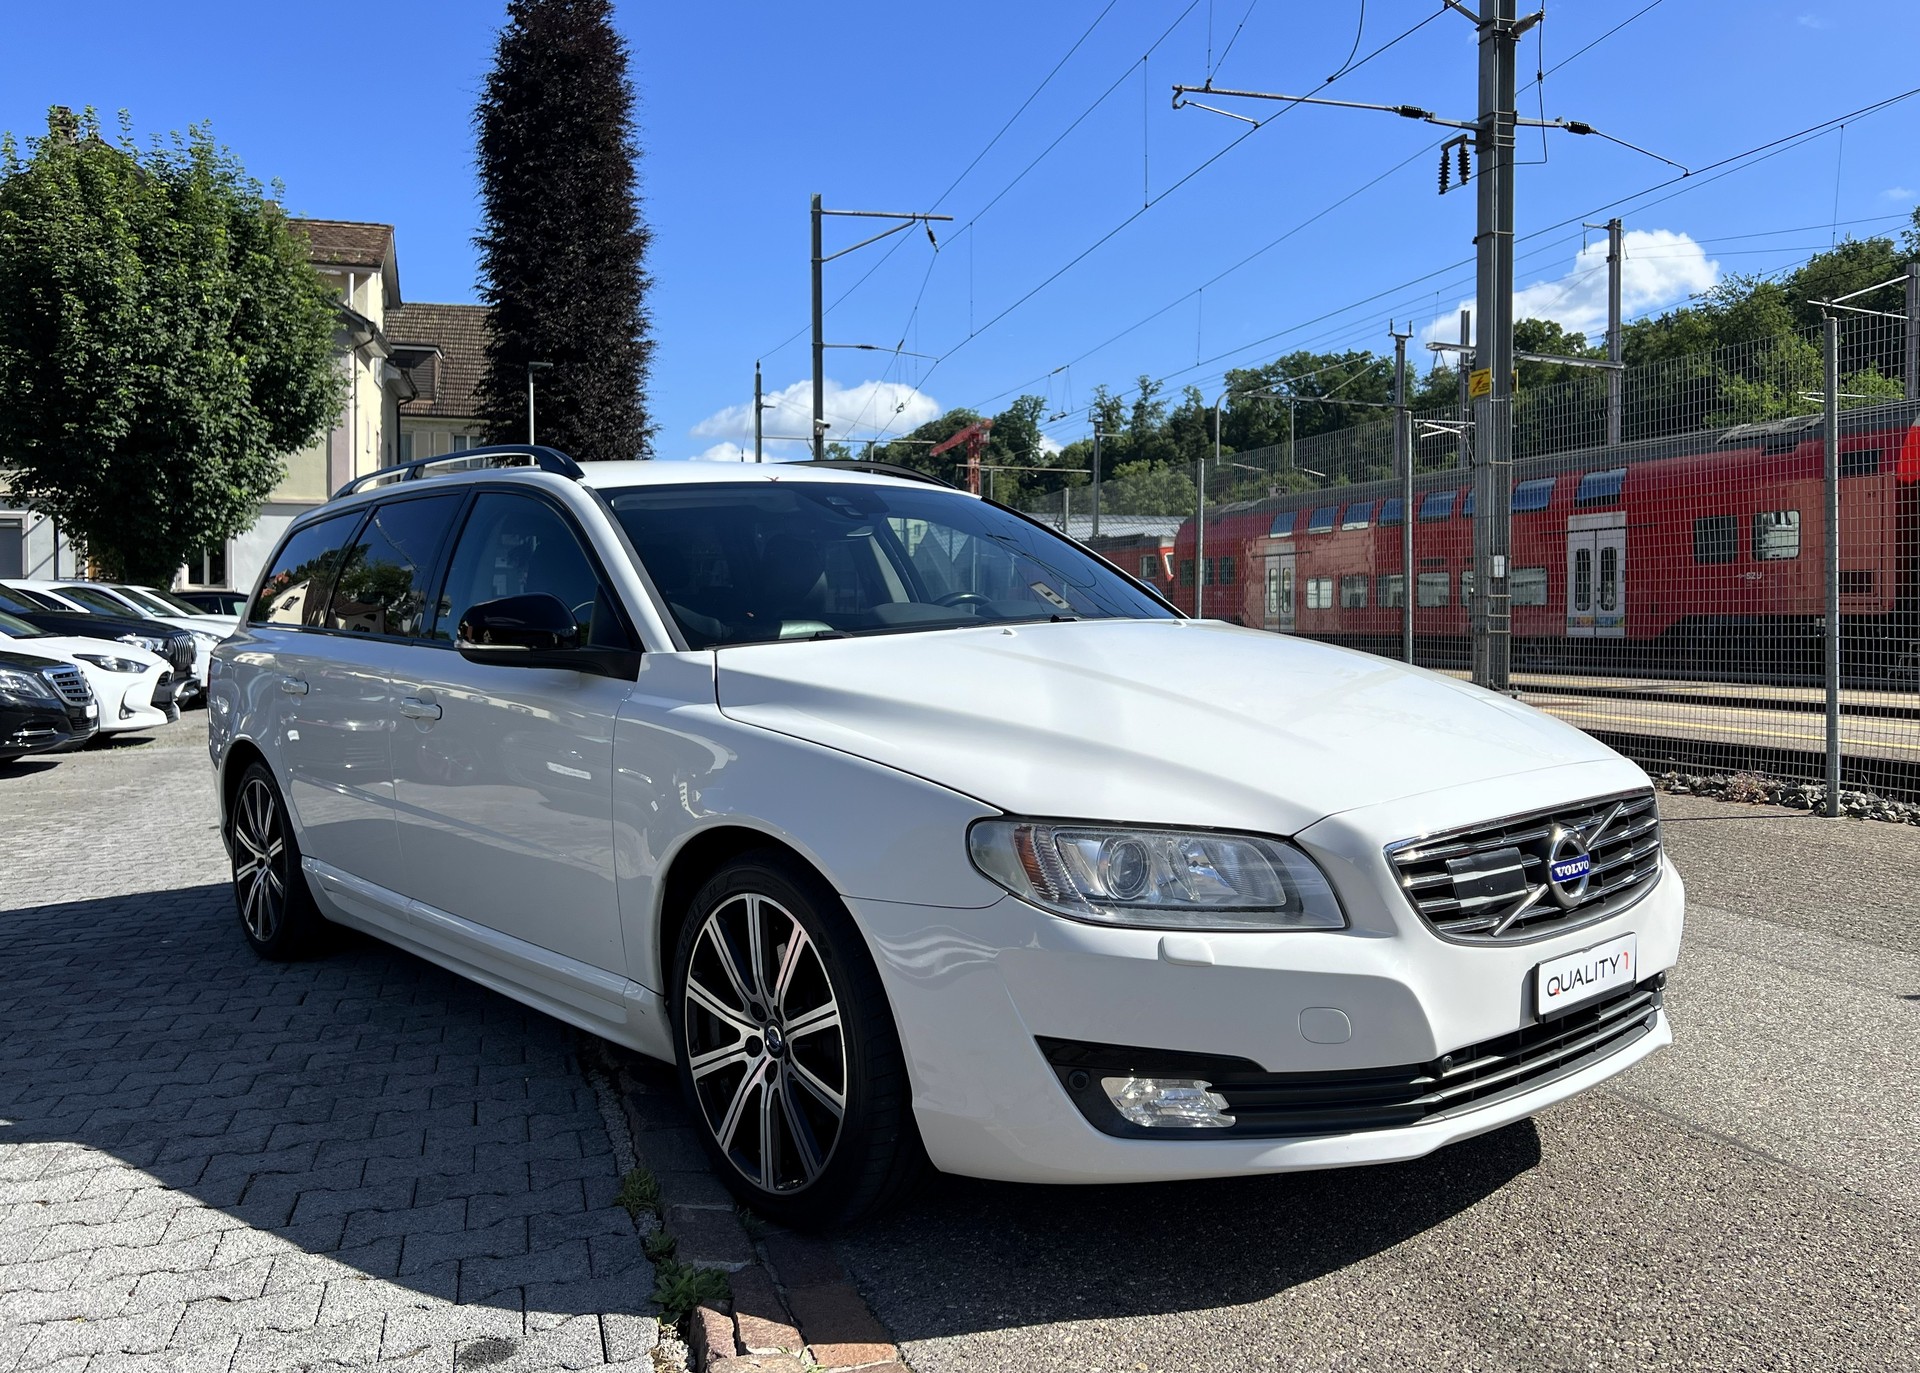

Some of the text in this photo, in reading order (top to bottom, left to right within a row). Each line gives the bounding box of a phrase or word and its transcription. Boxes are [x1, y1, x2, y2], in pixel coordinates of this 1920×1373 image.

[1555, 860, 1589, 877] VOLVO
[1547, 951, 1629, 997] QUALITY 1
